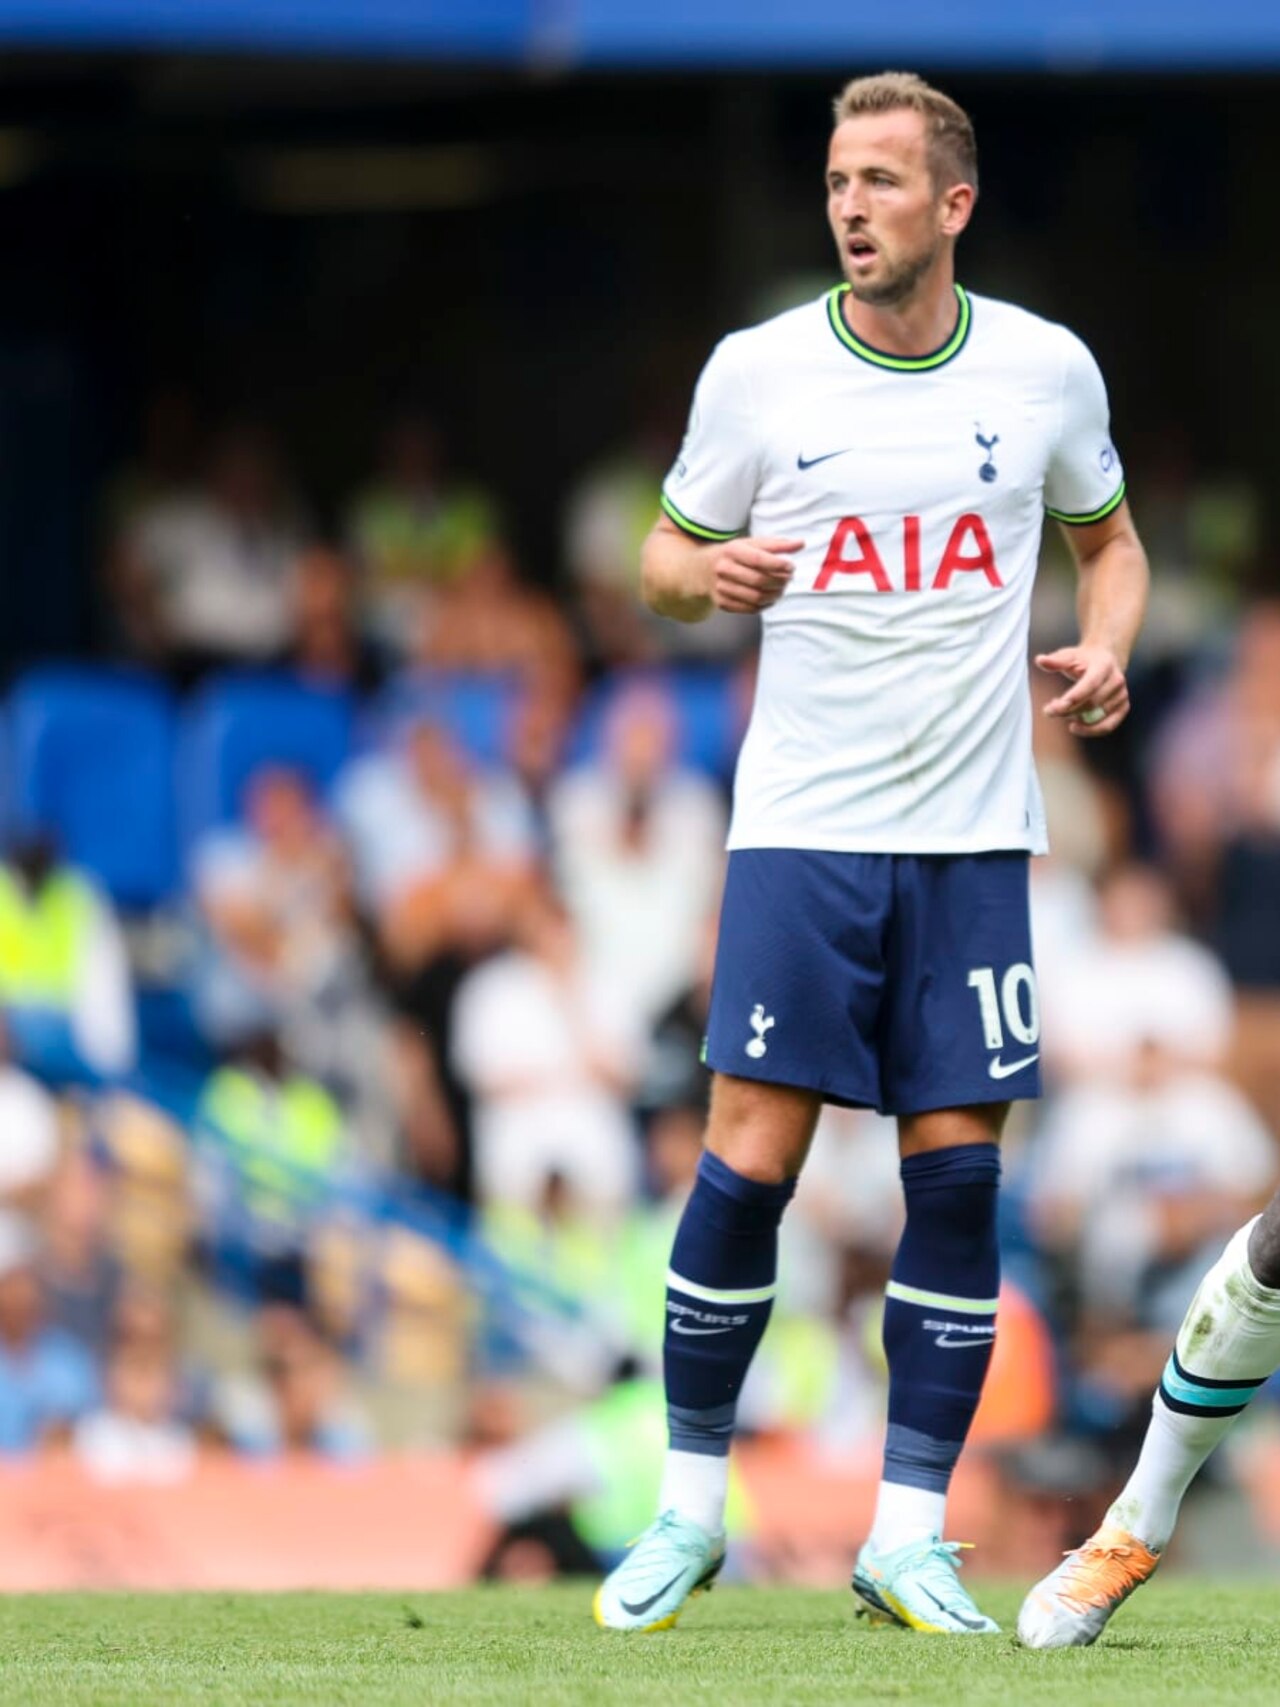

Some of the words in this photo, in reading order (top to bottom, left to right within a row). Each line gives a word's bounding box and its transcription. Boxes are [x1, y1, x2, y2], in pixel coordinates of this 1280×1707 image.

[811, 513, 1004, 593] AIA
[967, 966, 1040, 1050] 10
[922, 1319, 996, 1334] SPUR
